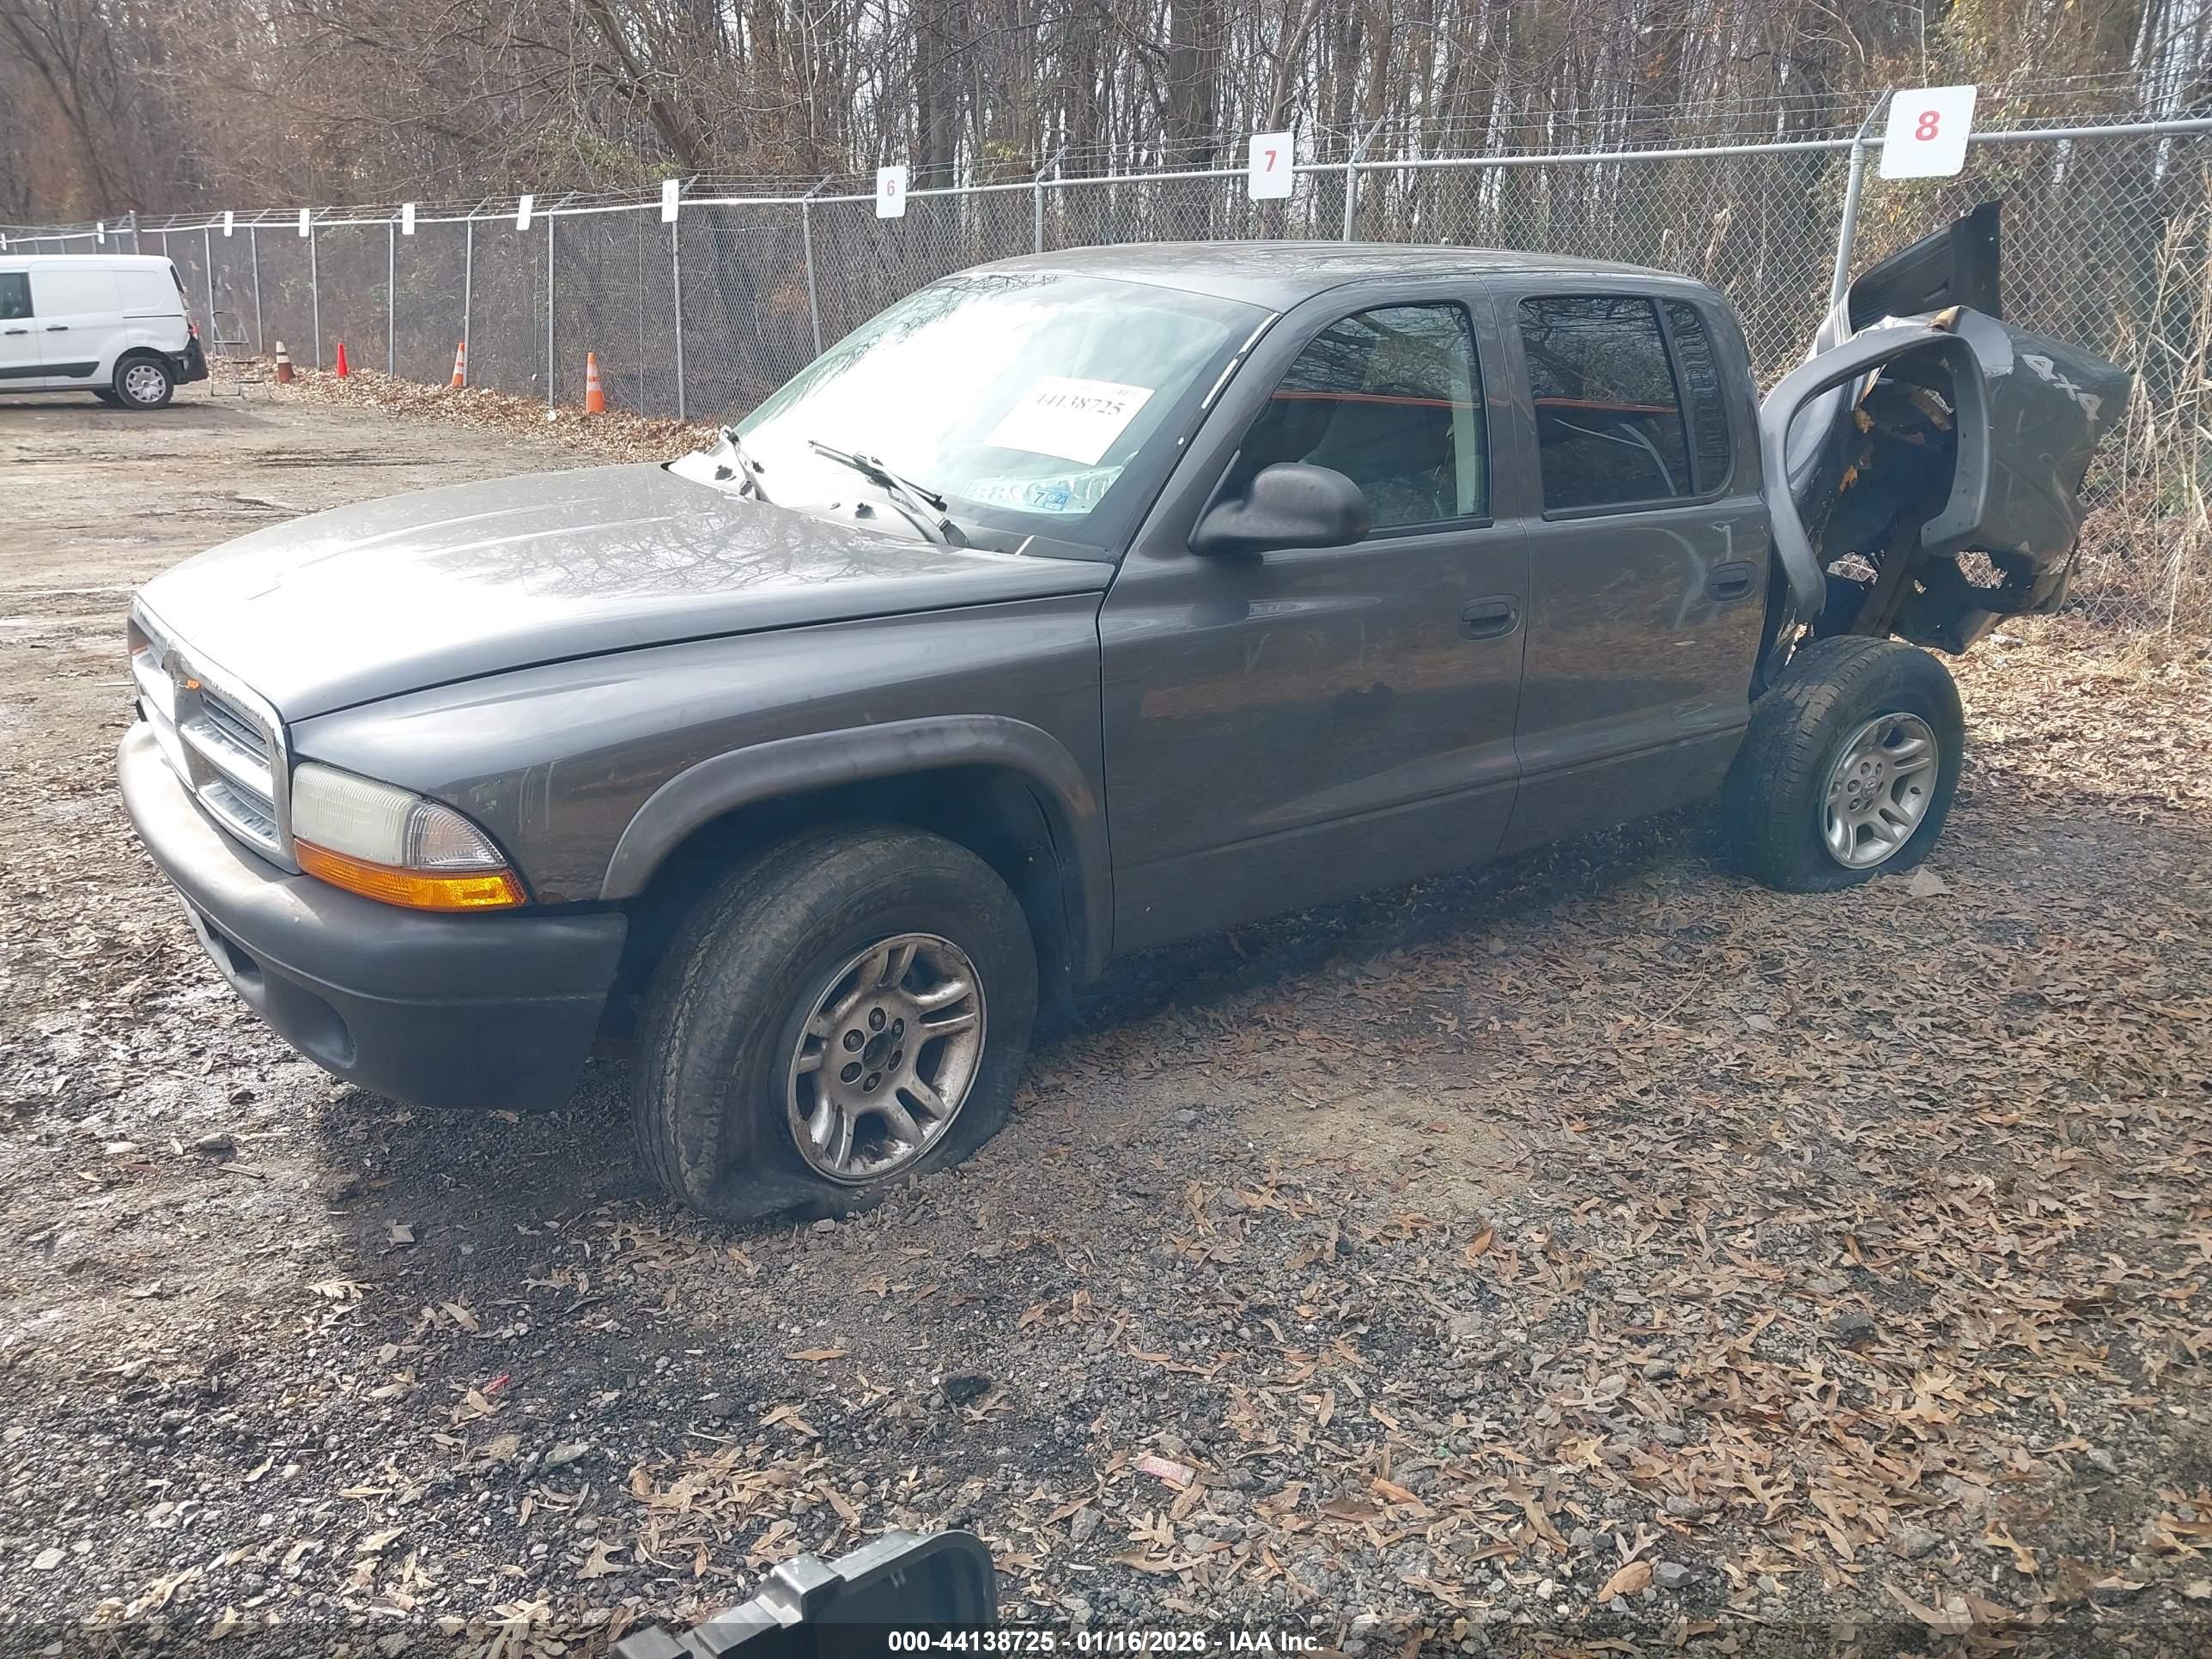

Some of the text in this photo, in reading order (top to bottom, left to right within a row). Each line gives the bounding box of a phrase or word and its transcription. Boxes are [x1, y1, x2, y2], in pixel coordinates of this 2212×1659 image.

[1915, 110, 1941, 141] 8
[1264, 149, 1277, 173] 7
[886, 179, 896, 197] 6
